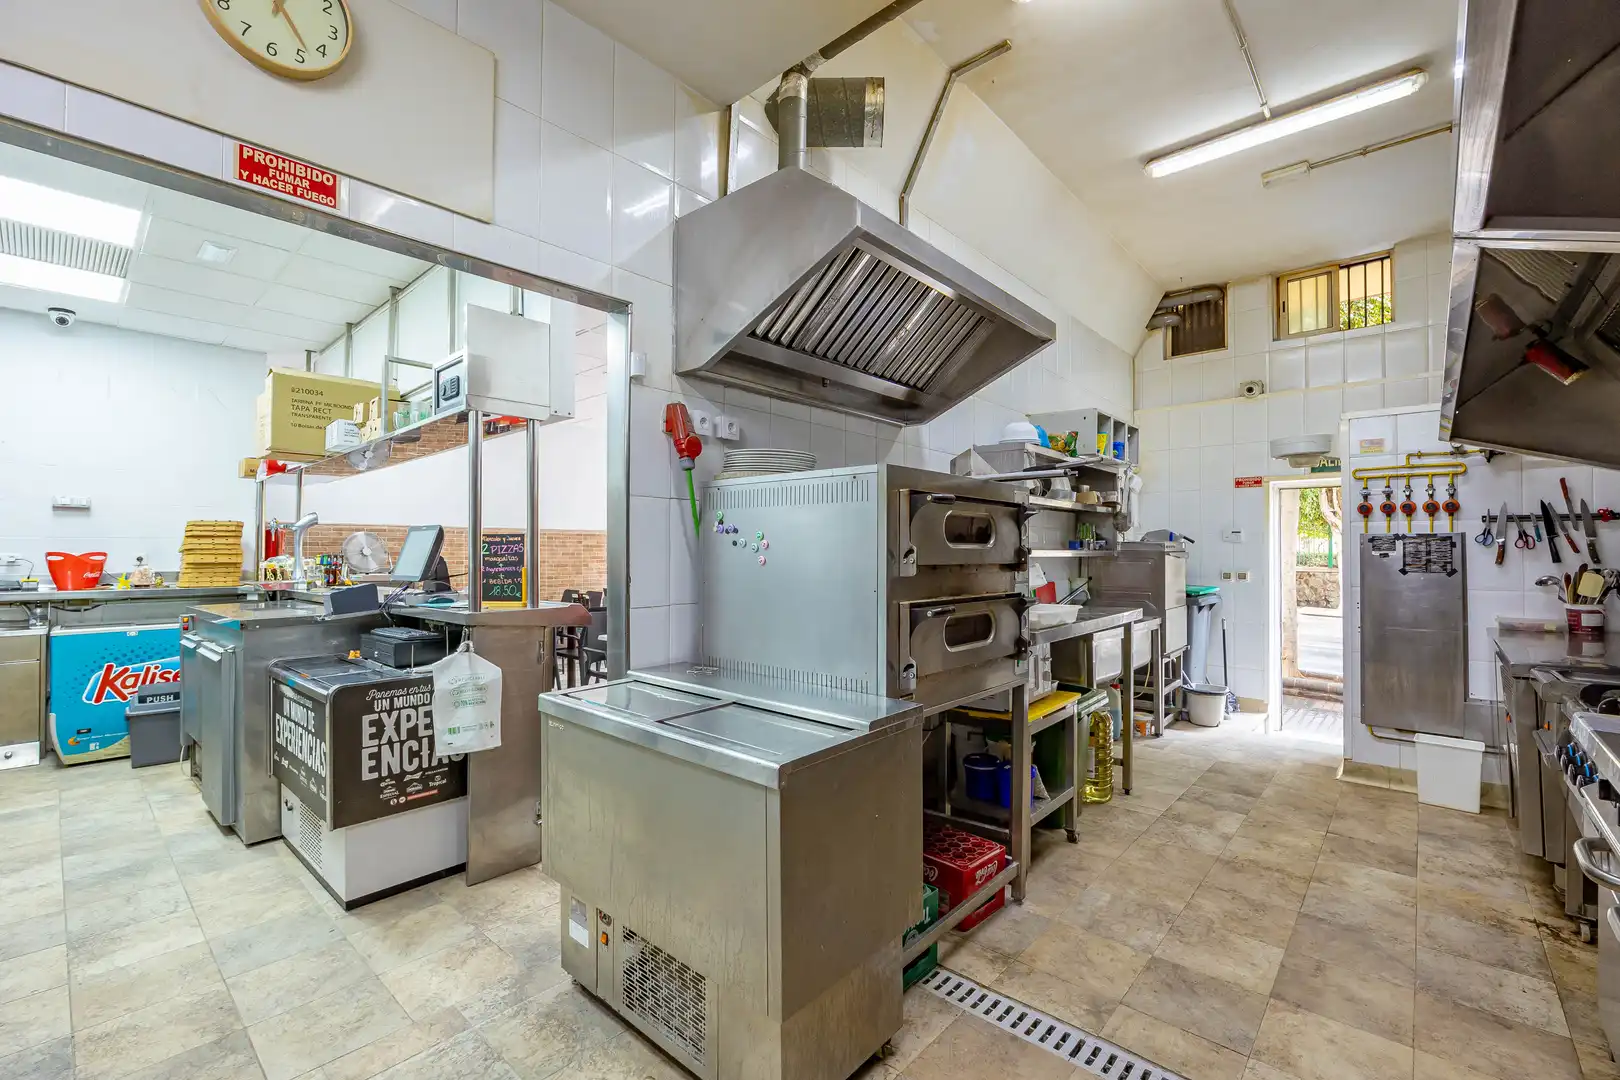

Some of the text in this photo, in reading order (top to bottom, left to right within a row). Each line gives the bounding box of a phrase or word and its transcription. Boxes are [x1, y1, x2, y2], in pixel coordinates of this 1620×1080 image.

[322, 0, 333, 16] 2
[240, 20, 252, 37] 7
[327, 24, 338, 41] 3
[266, 42, 278, 57] 6
[294, 48, 306, 64] 5
[315, 43, 328, 59] 4
[242, 146, 334, 186] PROHIBIDO
[268, 168, 310, 189] FUMAR
[240, 169, 335, 207] Y HACER FUEGO
[291, 404, 332, 415] TAPA RECT
[291, 412, 332, 421] TRANSPARENTE
[482, 543, 524, 554] 2 PIZZAS
[93, 663, 180, 704] Kalise
[146, 694, 174, 704] PUSH
[366, 688, 408, 700] Ponemos
[374, 692, 431, 711] UN MUNDO
[362, 705, 434, 748] EXPE
[275, 712, 327, 778] EXPERIENCIAS
[361, 737, 466, 782] ENCI
